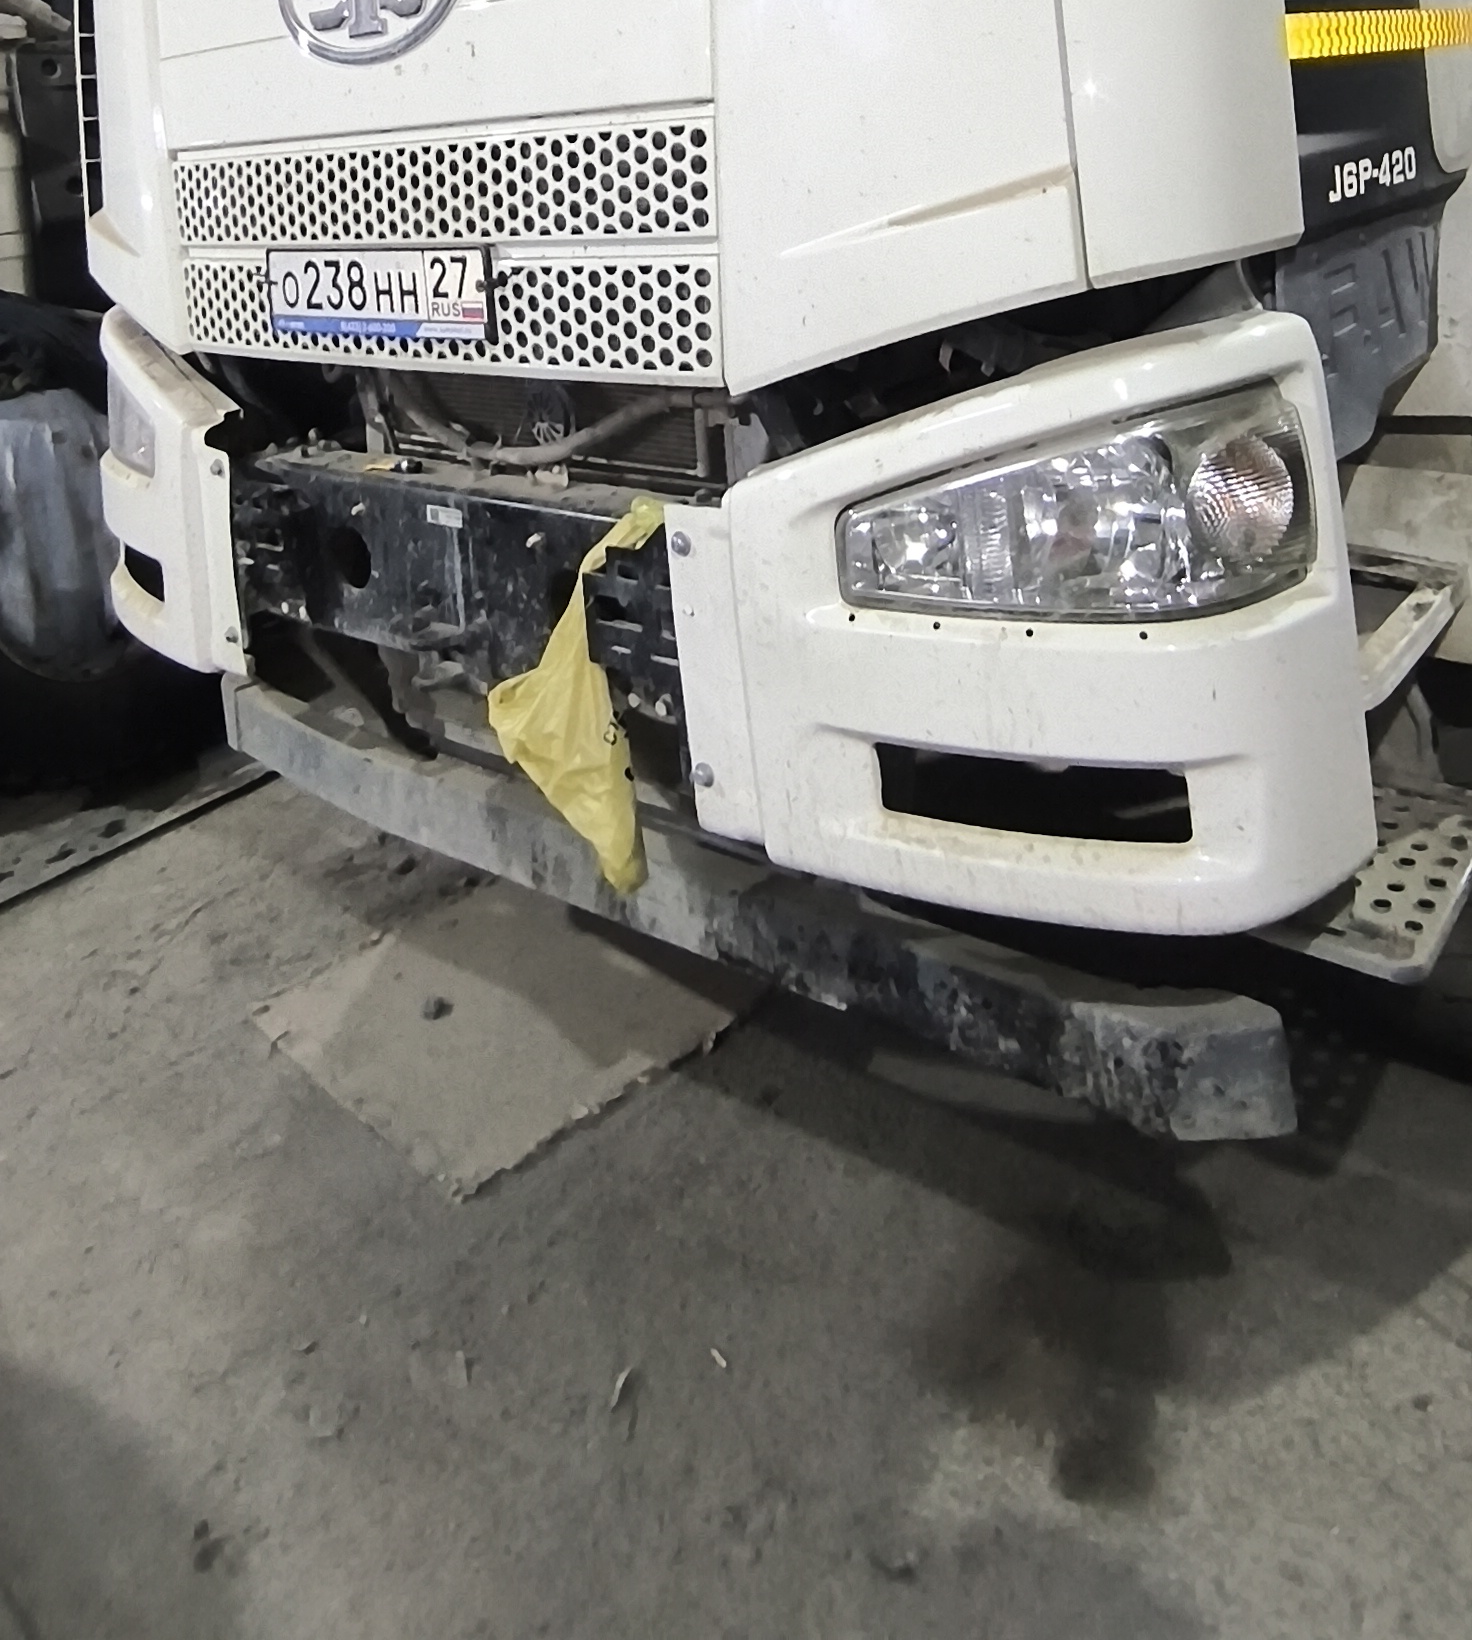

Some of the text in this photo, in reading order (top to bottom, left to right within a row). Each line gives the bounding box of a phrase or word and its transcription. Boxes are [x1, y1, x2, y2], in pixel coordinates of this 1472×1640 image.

[1329, 146, 1416, 203] J6P-420
[430, 256, 468, 299] 27
[431, 301, 462, 317] RUS
